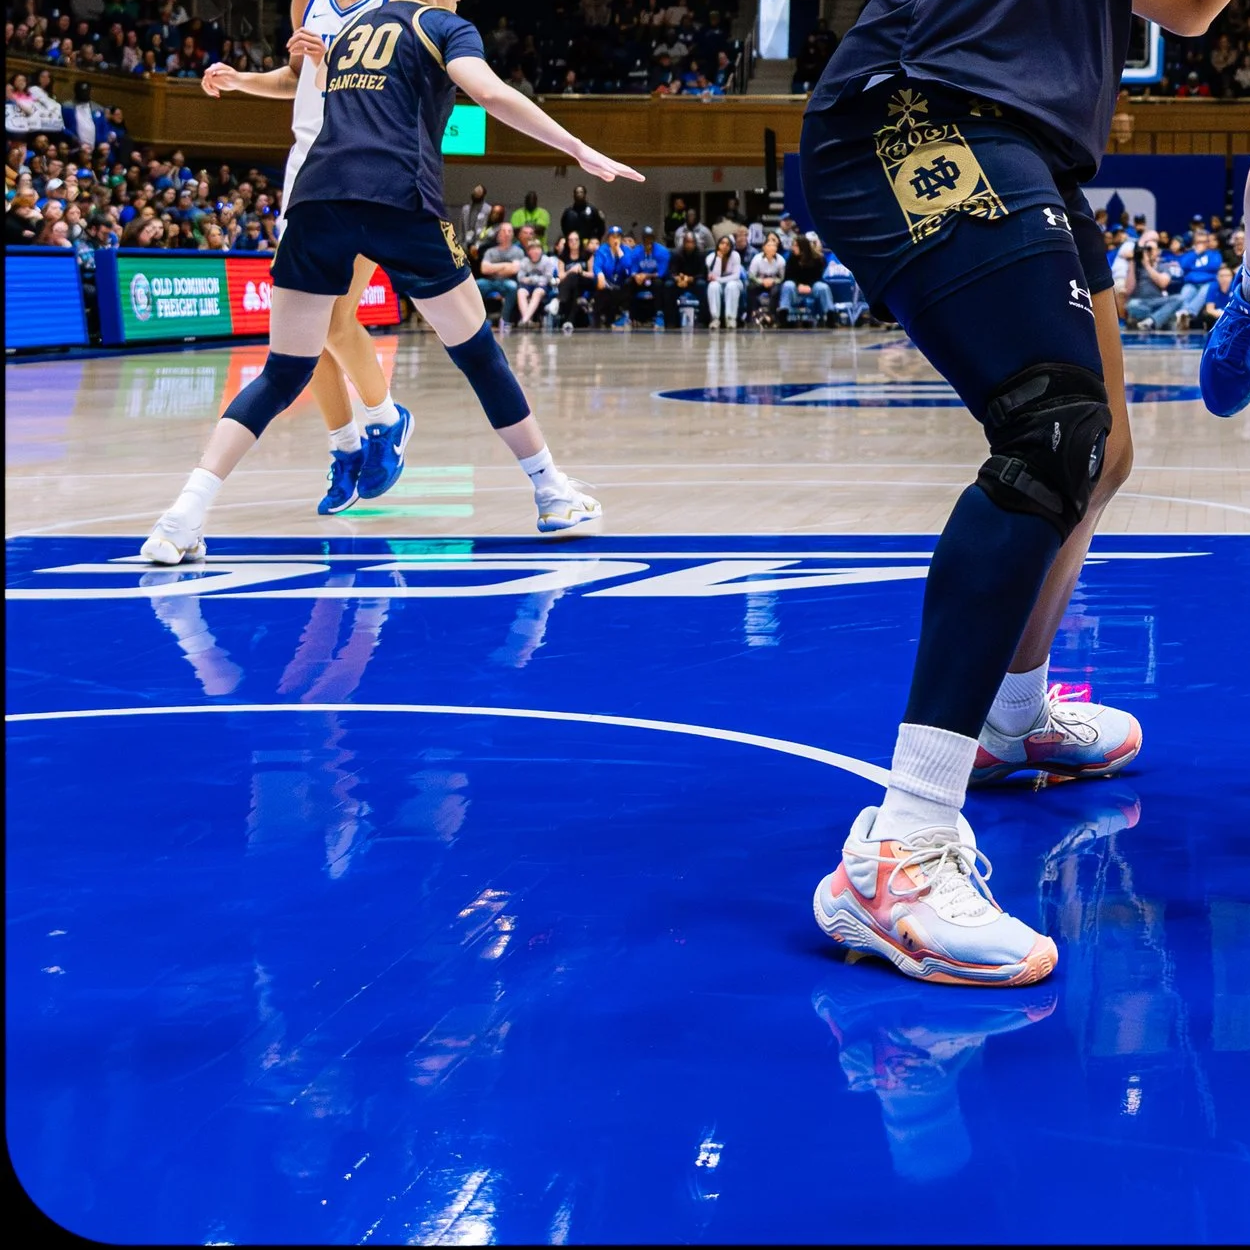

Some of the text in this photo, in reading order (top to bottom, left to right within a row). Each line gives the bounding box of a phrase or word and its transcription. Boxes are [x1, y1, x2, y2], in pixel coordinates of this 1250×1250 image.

[338, 22, 403, 71] 30
[328, 73, 387, 93] SANCHEZ
[151, 277, 220, 296] OLD DOMINION
[358, 284, 386, 305] arm
[156, 297, 220, 318] FREIGHT LINE
